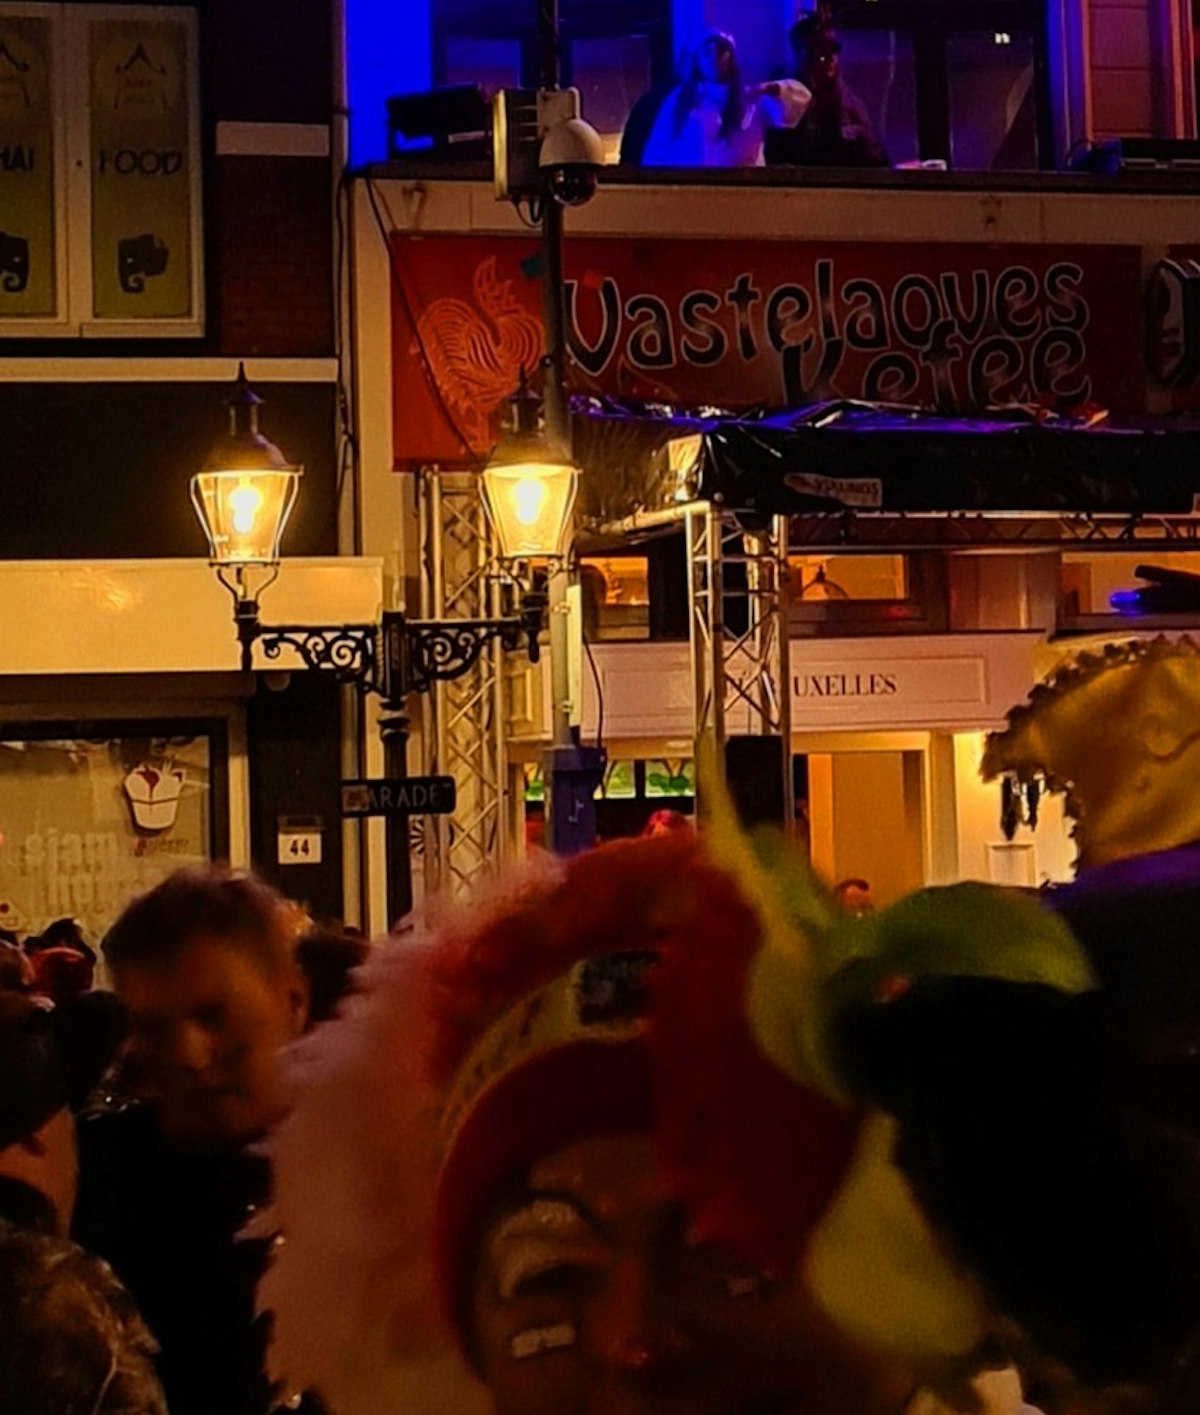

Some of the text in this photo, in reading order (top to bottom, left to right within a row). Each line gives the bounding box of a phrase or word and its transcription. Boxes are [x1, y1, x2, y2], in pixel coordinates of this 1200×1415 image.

[100, 148, 182, 175] FOOD
[565, 258, 1090, 377] Vastelaoves
[763, 675, 897, 696] UXELLES
[367, 783, 441, 809] ARADE
[289, 837, 310, 856] 44
